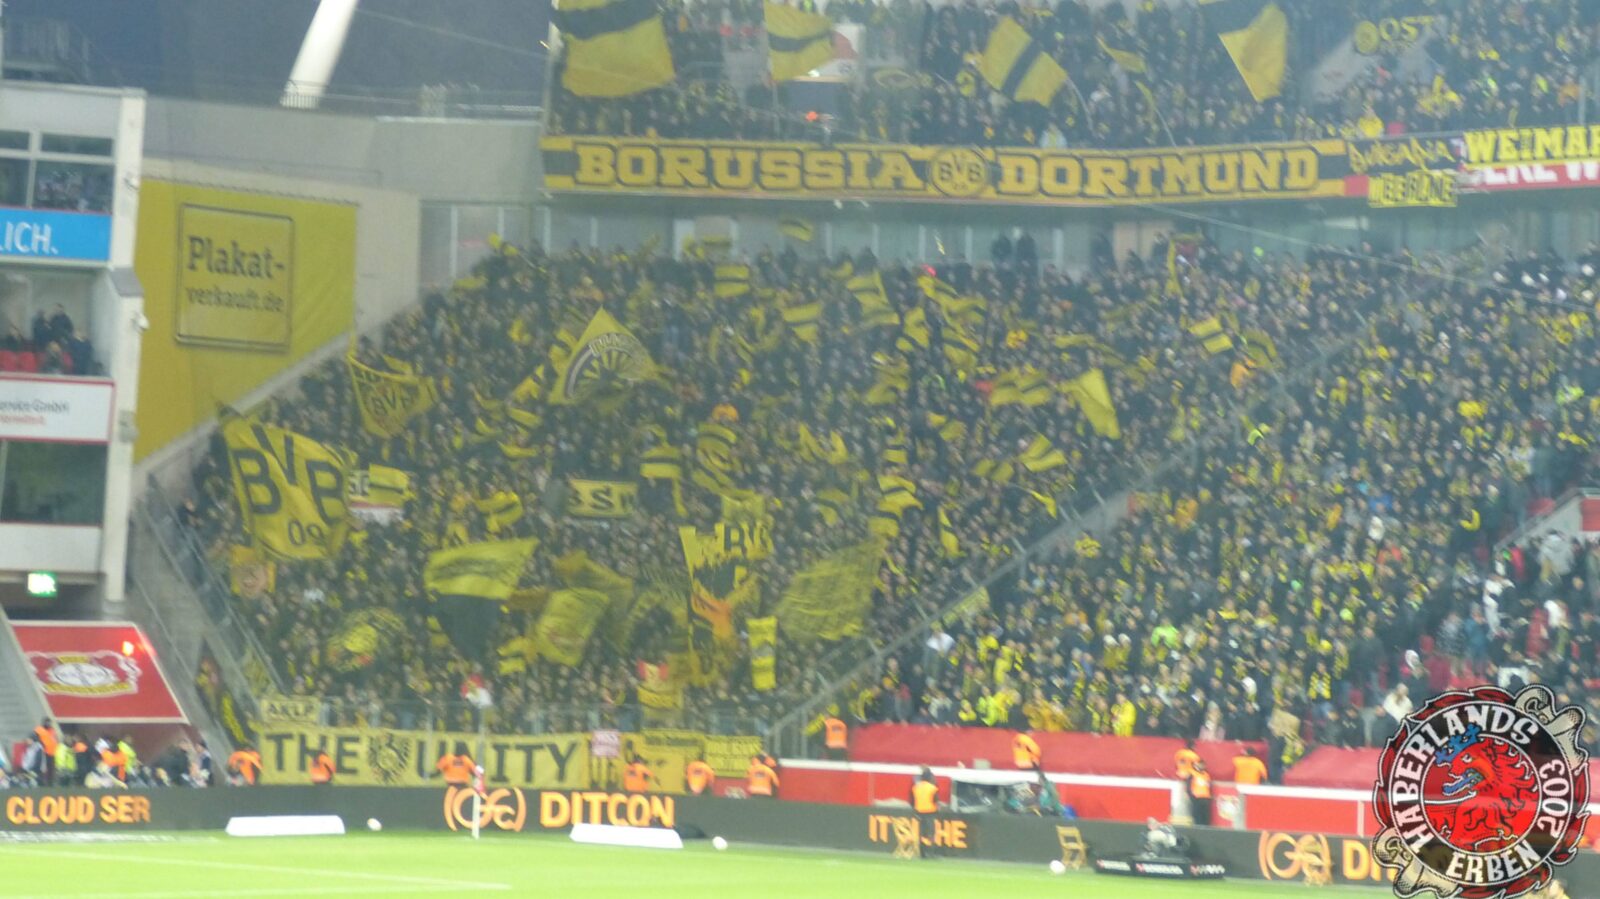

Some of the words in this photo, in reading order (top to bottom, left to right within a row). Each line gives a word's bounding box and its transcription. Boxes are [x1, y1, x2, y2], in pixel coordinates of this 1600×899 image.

[574, 142, 926, 191] BORUSSIA
[940, 152, 982, 182] BVB
[999, 147, 1319, 198] DORTMUND
[0, 221, 59, 255] ICH.
[187, 236, 286, 279] Plakat-
[186, 286, 284, 312] verkauft.de
[228, 424, 344, 526] BVB
[265, 733, 361, 776] THE
[6, 795, 96, 825] CLOUD
[99, 795, 152, 823] SER
[540, 791, 675, 828] DITCON
